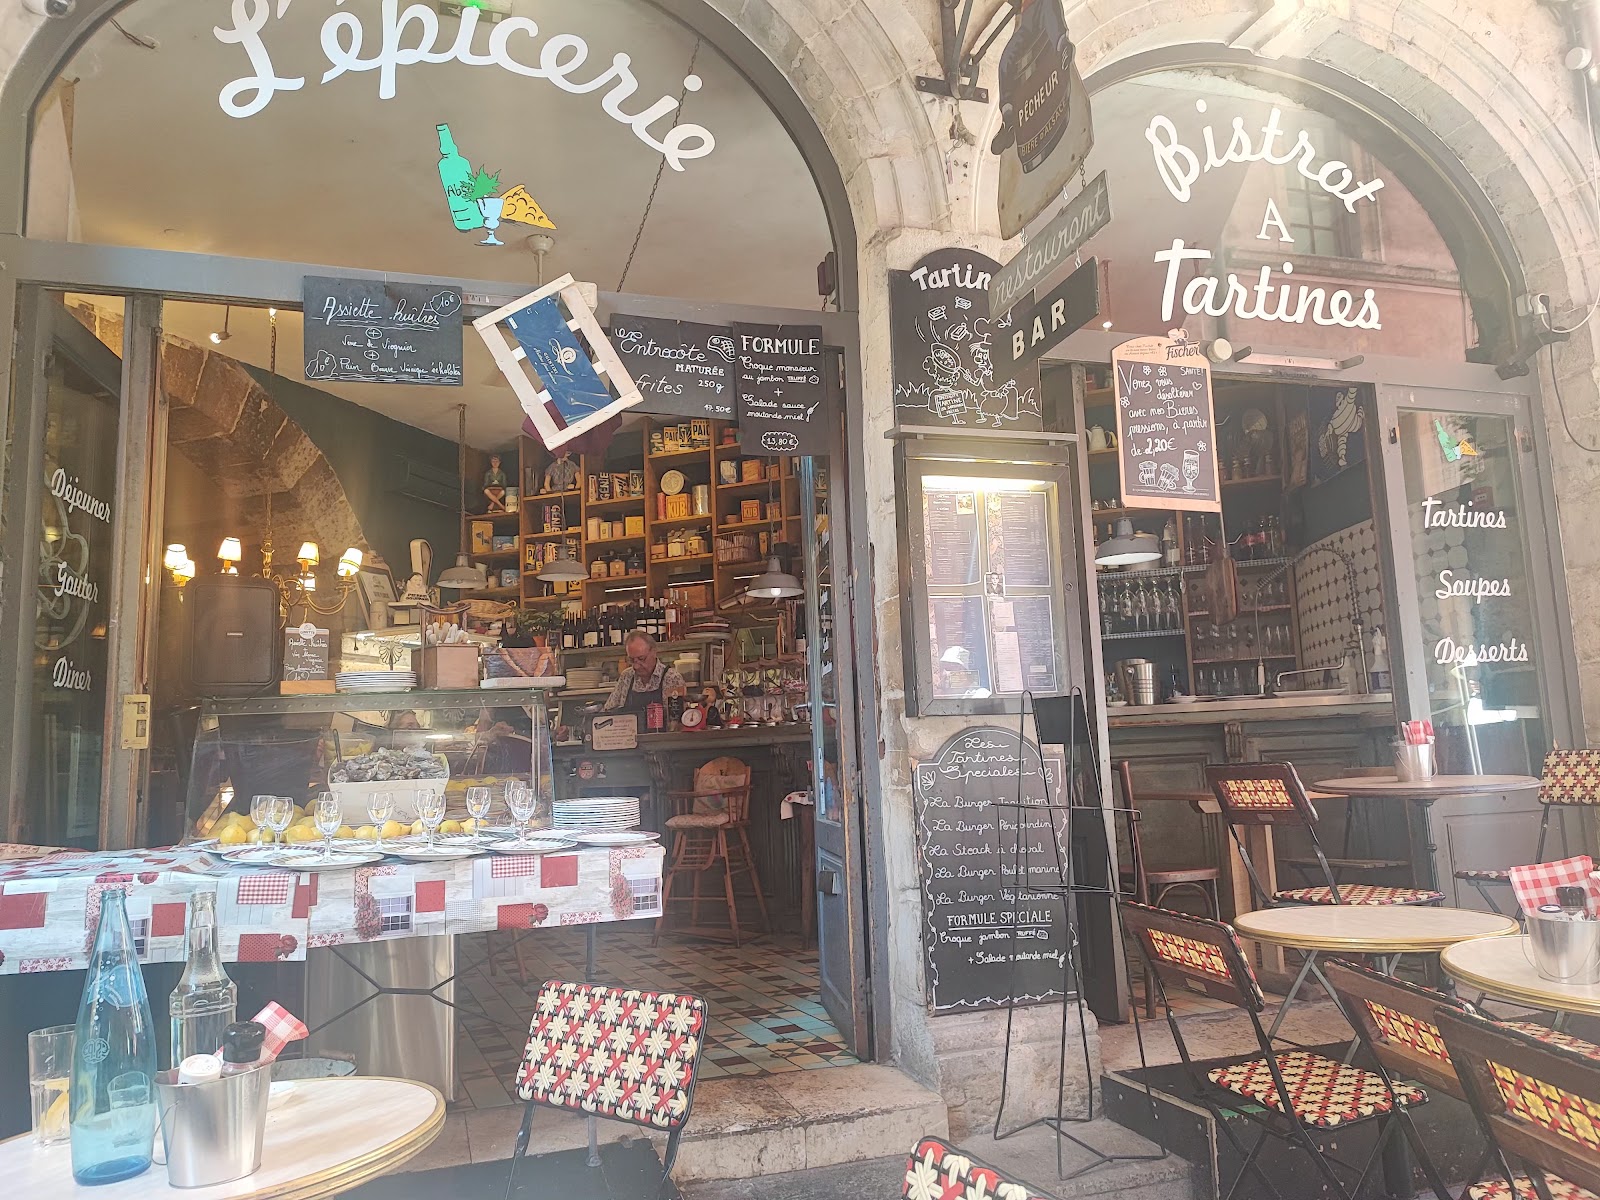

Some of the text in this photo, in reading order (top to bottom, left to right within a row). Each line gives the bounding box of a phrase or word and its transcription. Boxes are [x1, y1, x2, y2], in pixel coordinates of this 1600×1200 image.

[213, 0, 716, 172] L'épicerie
[1018, 70, 1058, 127] PÊCHEUR
[1144, 98, 1385, 214] Bistrot
[1256, 197, 1295, 243] A
[992, 184, 1106, 315] restaurant
[910, 263, 992, 291] Tartin
[1154, 238, 1383, 331] Tartines
[323, 296, 382, 325] Assiette
[1012, 298, 1067, 361] BAR
[614, 328, 709, 363] Entrecôte
[741, 335, 820, 355] FORMULE
[1165, 341, 1201, 361] Fischer
[339, 357, 363, 372] Pain
[675, 362, 725, 377] MATURÉE
[739, 355, 818, 374] Croque monsieur
[635, 374, 684, 395] frites
[756, 374, 784, 385] jambon
[1118, 364, 1174, 395] Venez vous
[742, 393, 779, 408] Salade
[747, 411, 805, 421] moutarde miel
[1128, 408, 1147, 419] avec
[1149, 407, 1165, 417] nos
[1173, 419, 1181, 429] à
[1181, 416, 1208, 435] partir
[51, 467, 111, 524] Déjeuner
[668, 501, 686, 517] KUB
[744, 507, 758, 518] KUB
[1421, 496, 1507, 529] Tartines
[1435, 569, 1512, 605] Soupes
[1434, 636, 1529, 664] Desserts
[964, 737, 1010, 750] Les
[947, 750, 1027, 765] Tartines
[929, 796, 951, 808] La
[954, 795, 995, 812] Burger
[932, 819, 952, 831] La
[955, 819, 994, 835] Burger
[929, 844, 949, 857] La
[934, 865, 954, 878] La
[957, 865, 997, 880] Burger
[935, 888, 1060, 906] La Burger Végtarienne
[946, 912, 997, 926] FORMULE
[939, 930, 973, 948] Croque
[978, 930, 1011, 945] jambon
[974, 951, 1006, 965] Salade
[1042, 949, 1059, 960] miel
